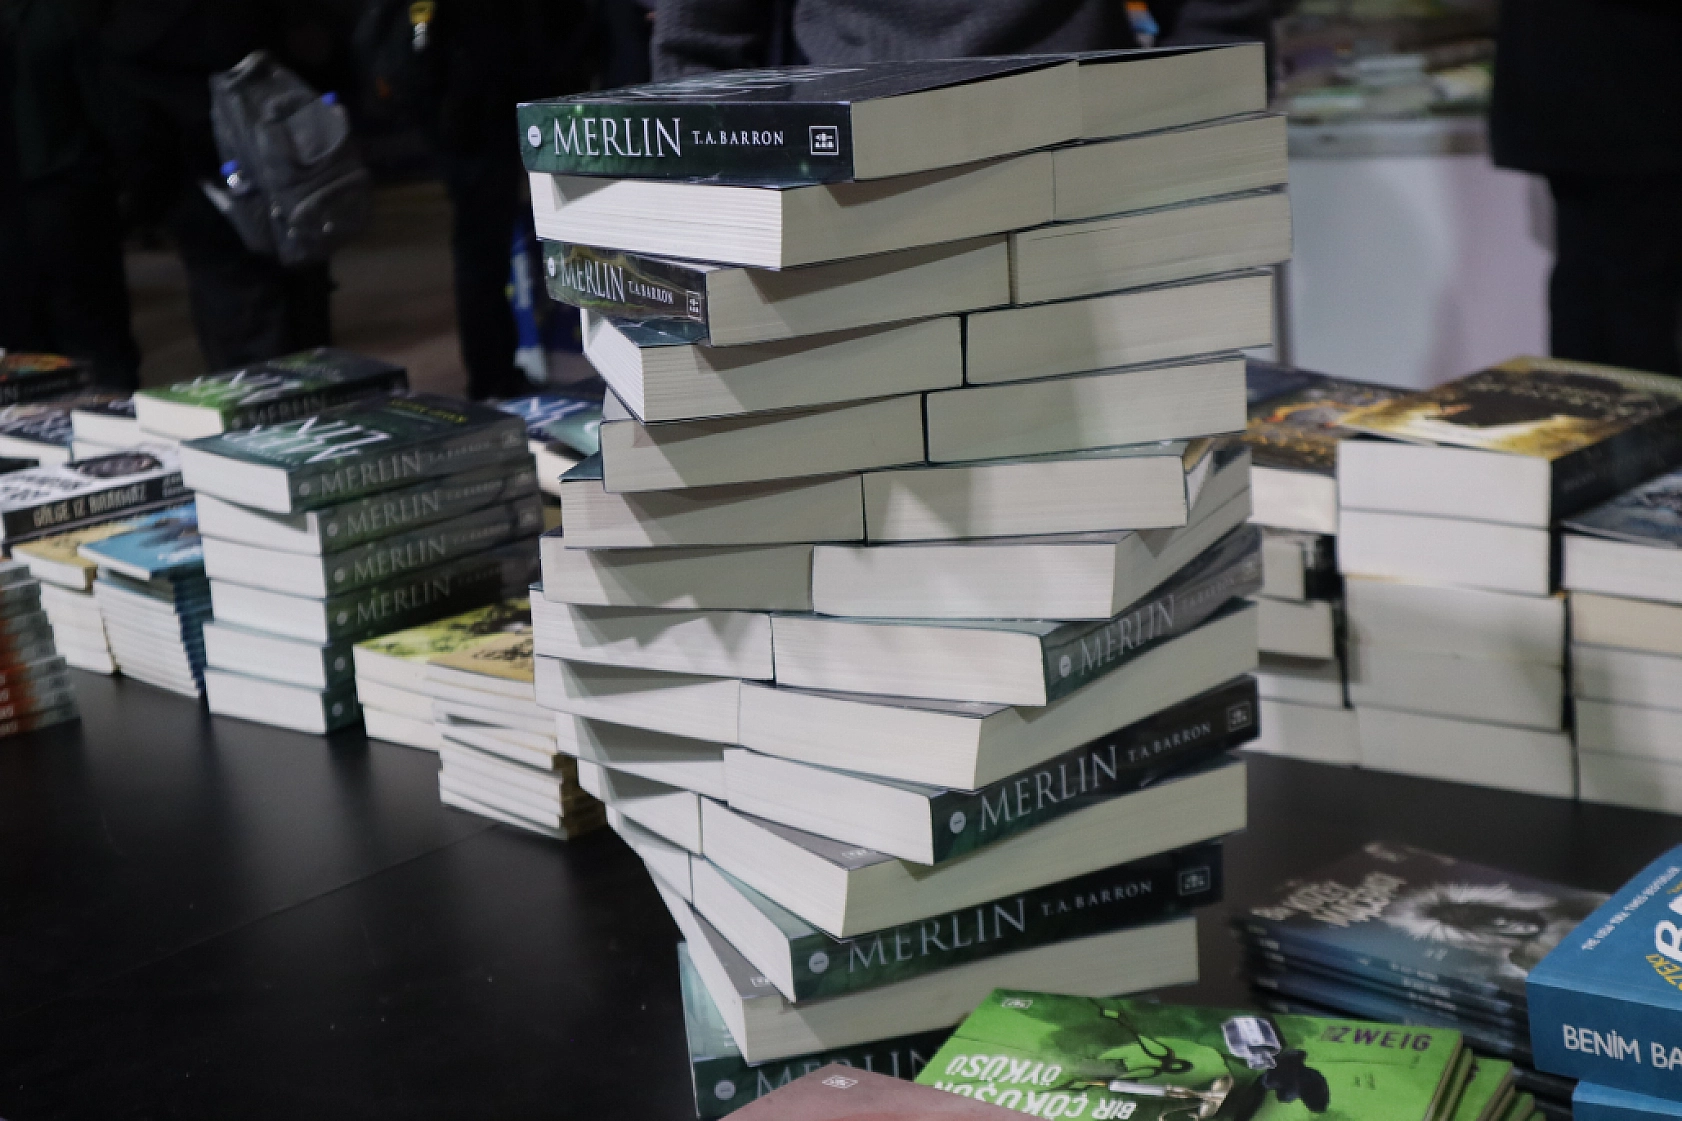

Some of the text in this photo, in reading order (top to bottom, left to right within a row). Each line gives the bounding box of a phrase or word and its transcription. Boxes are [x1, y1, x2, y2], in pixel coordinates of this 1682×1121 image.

[553, 117, 682, 158] MERLIN
[561, 253, 625, 303] MERLIN
[320, 449, 422, 498] MERLIN
[347, 489, 441, 537] MERLIN
[355, 533, 447, 583] MERLIN
[357, 576, 450, 625] MERLIN
[1080, 594, 1177, 676] MERLIN
[978, 745, 1118, 833] MERLIN
[848, 898, 1026, 973] MERLIN
[1329, 1026, 1432, 1052] ZWEIG
[1562, 1023, 1641, 1064] BENİM
[944, 1054, 1062, 1086] ÖYKÜSÜ
